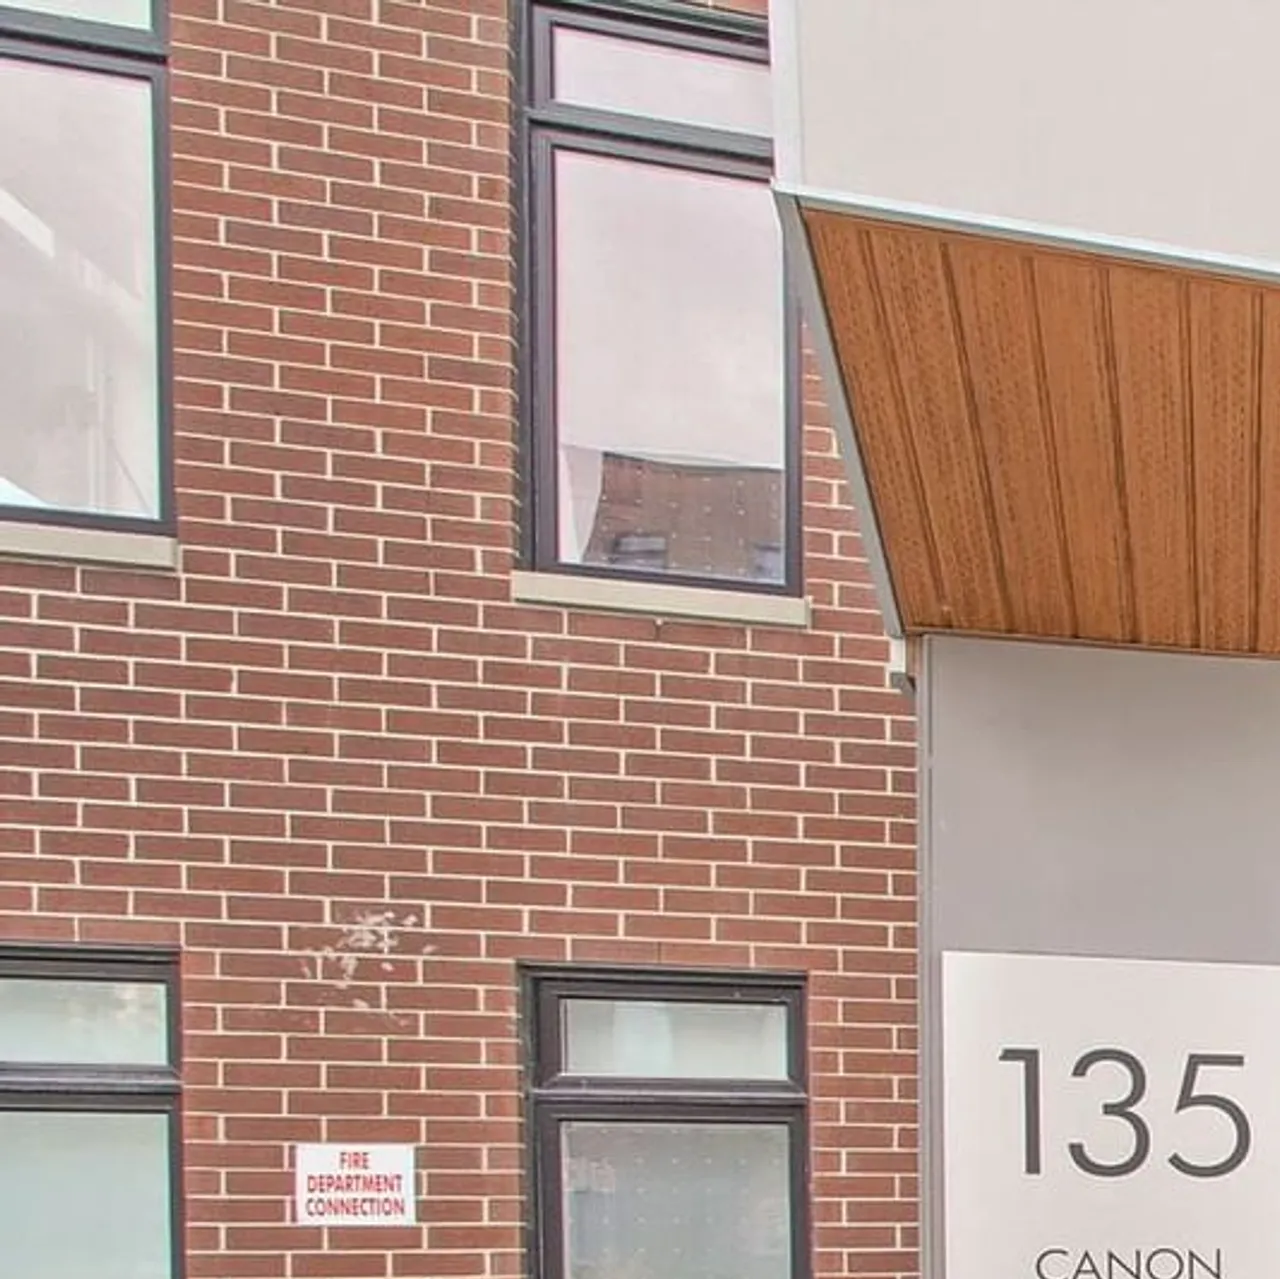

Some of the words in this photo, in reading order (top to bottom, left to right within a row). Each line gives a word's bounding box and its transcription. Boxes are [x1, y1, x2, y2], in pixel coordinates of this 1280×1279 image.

[998, 1047, 1252, 1178] 135
[340, 1152, 369, 1169] FIRE
[307, 1174, 403, 1193] DEPARTMENT
[306, 1197, 405, 1216] CONNECTION
